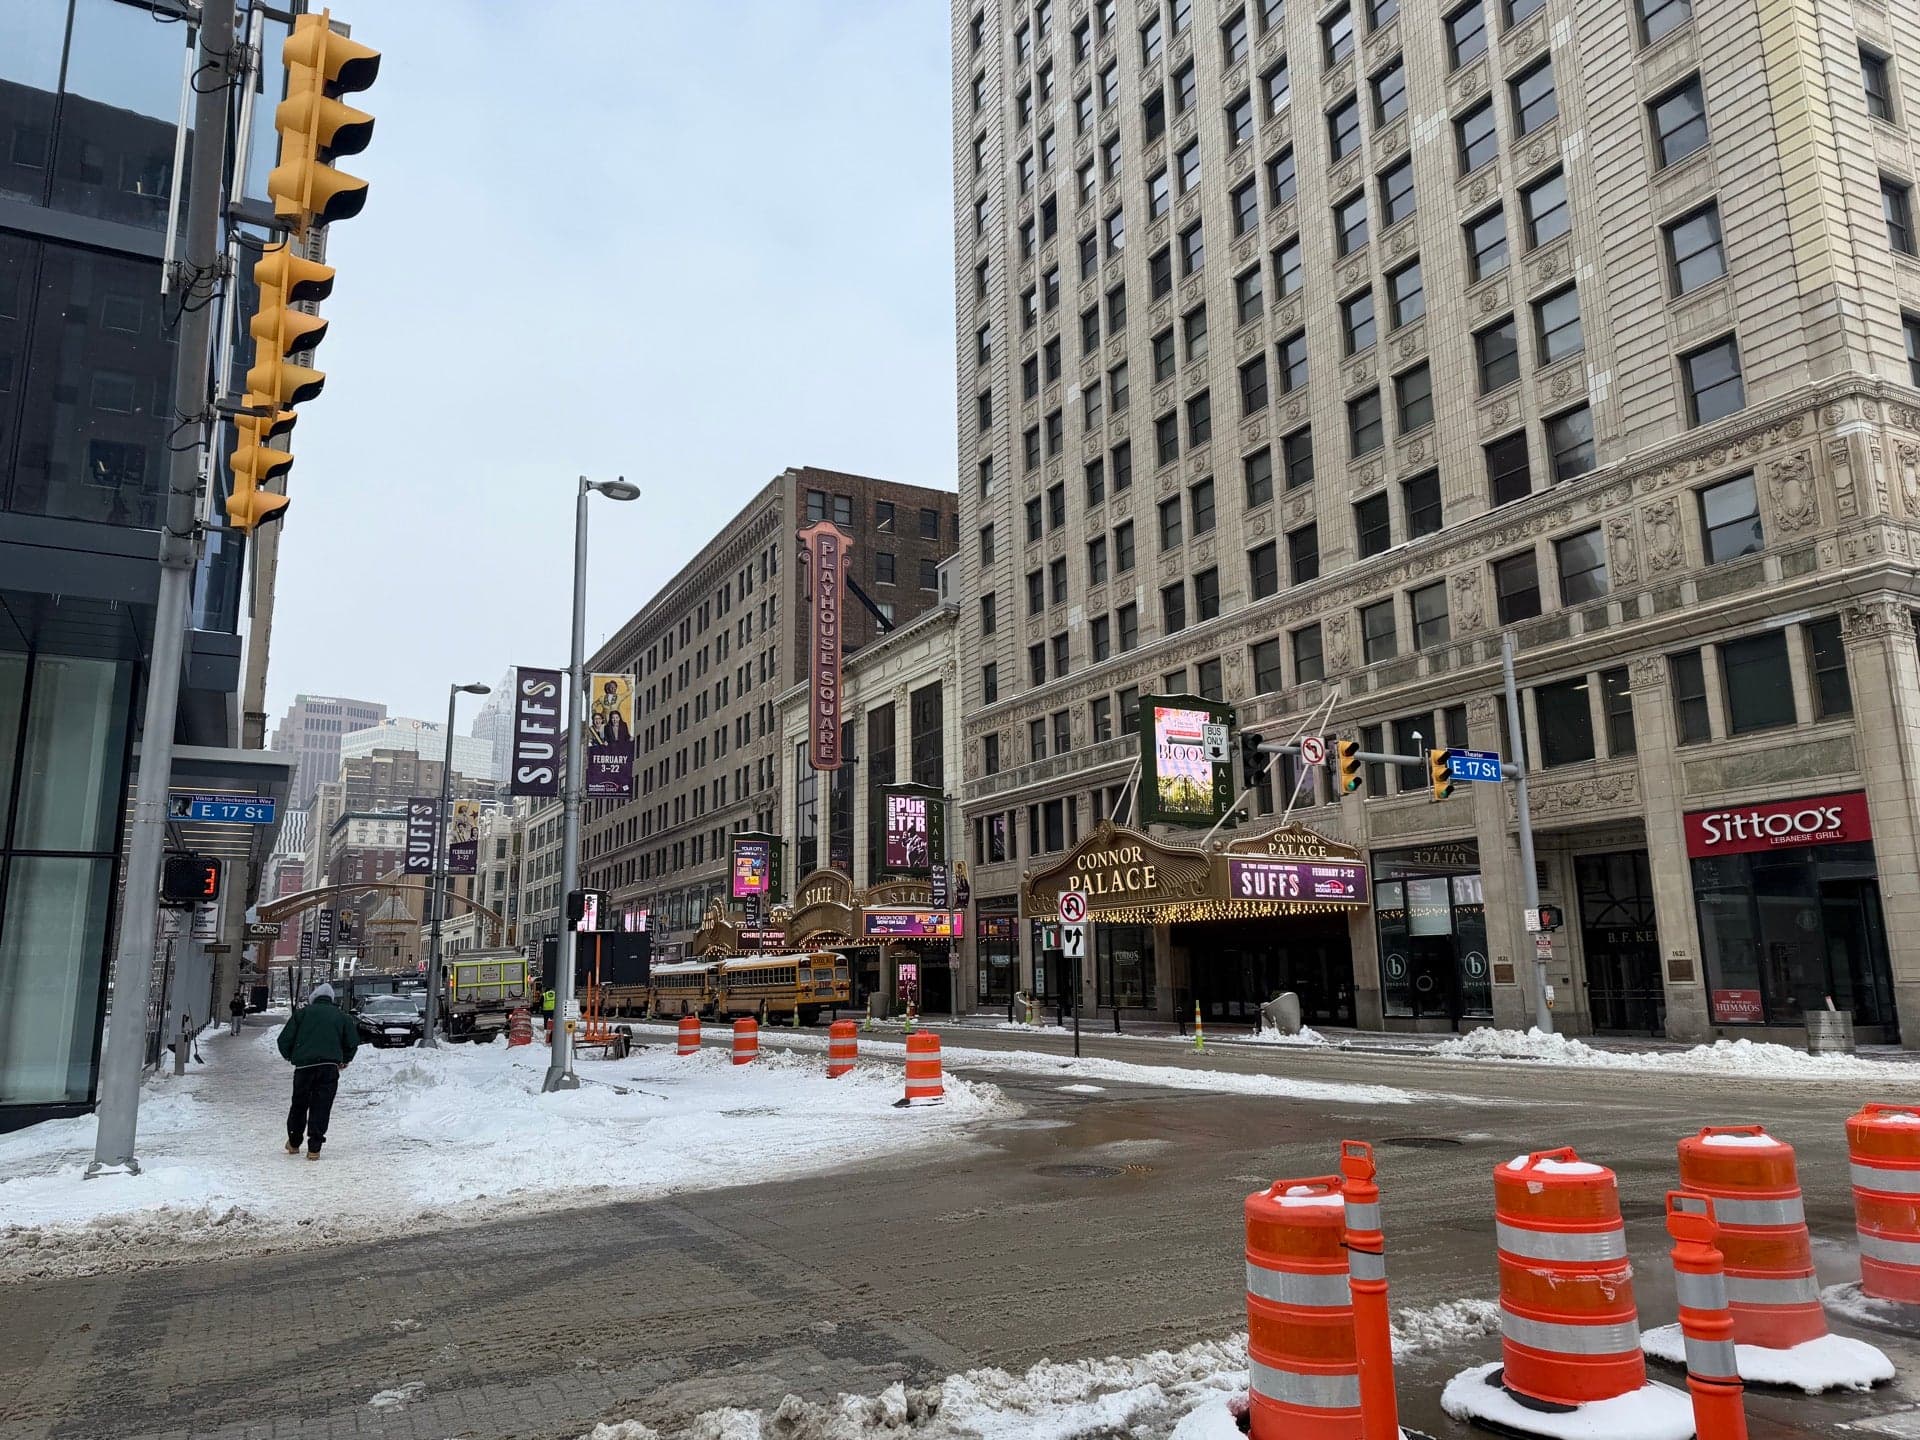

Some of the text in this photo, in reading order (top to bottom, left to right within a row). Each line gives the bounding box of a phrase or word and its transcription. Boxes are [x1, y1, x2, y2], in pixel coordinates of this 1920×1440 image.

[819, 541, 834, 759] PLAYHOUSE SQUARE
[421, 722, 438, 731] PNC
[517, 679, 556, 784] SUFFS
[1207, 727, 1221, 735] BUS
[1206, 736, 1223, 746] ONLY
[593, 755, 628, 764] FEBRUARY
[1217, 716, 1227, 812] PACE
[1453, 760, 1497, 777] E. 17 St
[201, 805, 264, 819] E. 17 St
[408, 804, 433, 867] SUFFS
[1274, 833, 1319, 845] CONNOR
[1770, 830, 1844, 844] LEBANESE GRILL
[1077, 846, 1144, 871] CONNOR
[1268, 843, 1327, 857] PALACE
[203, 868, 216, 894] 3
[1069, 865, 1157, 895] PALACE
[1311, 867, 1338, 877] FEBRUARY
[932, 864, 946, 905] SUFFS
[1241, 871, 1300, 897] SUFFS
[806, 887, 831, 906] STATE
[891, 892, 933, 904] STATE
[746, 896, 756, 926] SUFFS
[319, 911, 332, 942] SUFFS
[1622, 931, 1632, 943] F.
[1390, 958, 1401, 976] b
[1470, 956, 1481, 974] b
